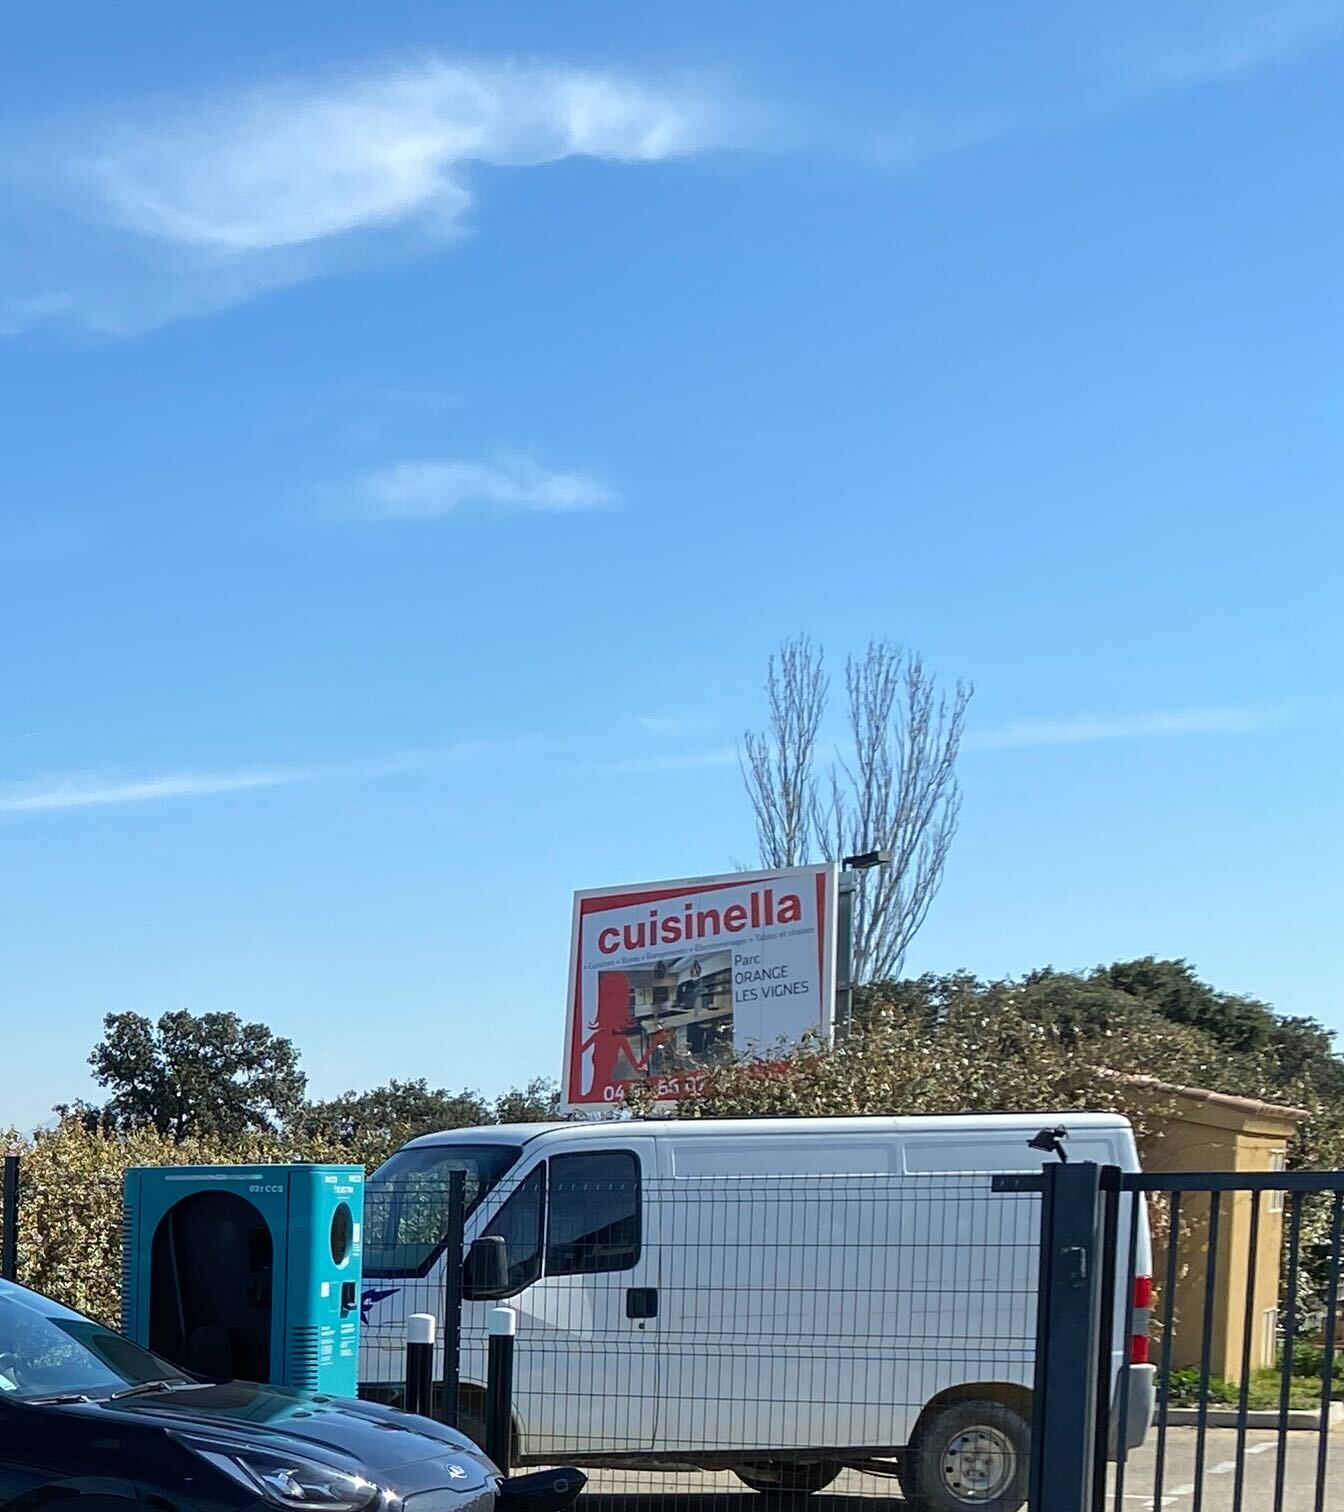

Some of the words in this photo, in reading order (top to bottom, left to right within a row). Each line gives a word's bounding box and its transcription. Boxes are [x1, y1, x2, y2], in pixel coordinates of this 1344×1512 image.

[597, 889, 801, 955] cuisinella
[734, 954, 760, 966] Parc
[735, 965, 789, 985] ORANGE
[735, 988, 758, 1003] LES
[761, 981, 809, 999] VIGNES
[604, 1084, 624, 1101] 04
[264, 1184, 283, 1193] CCS
